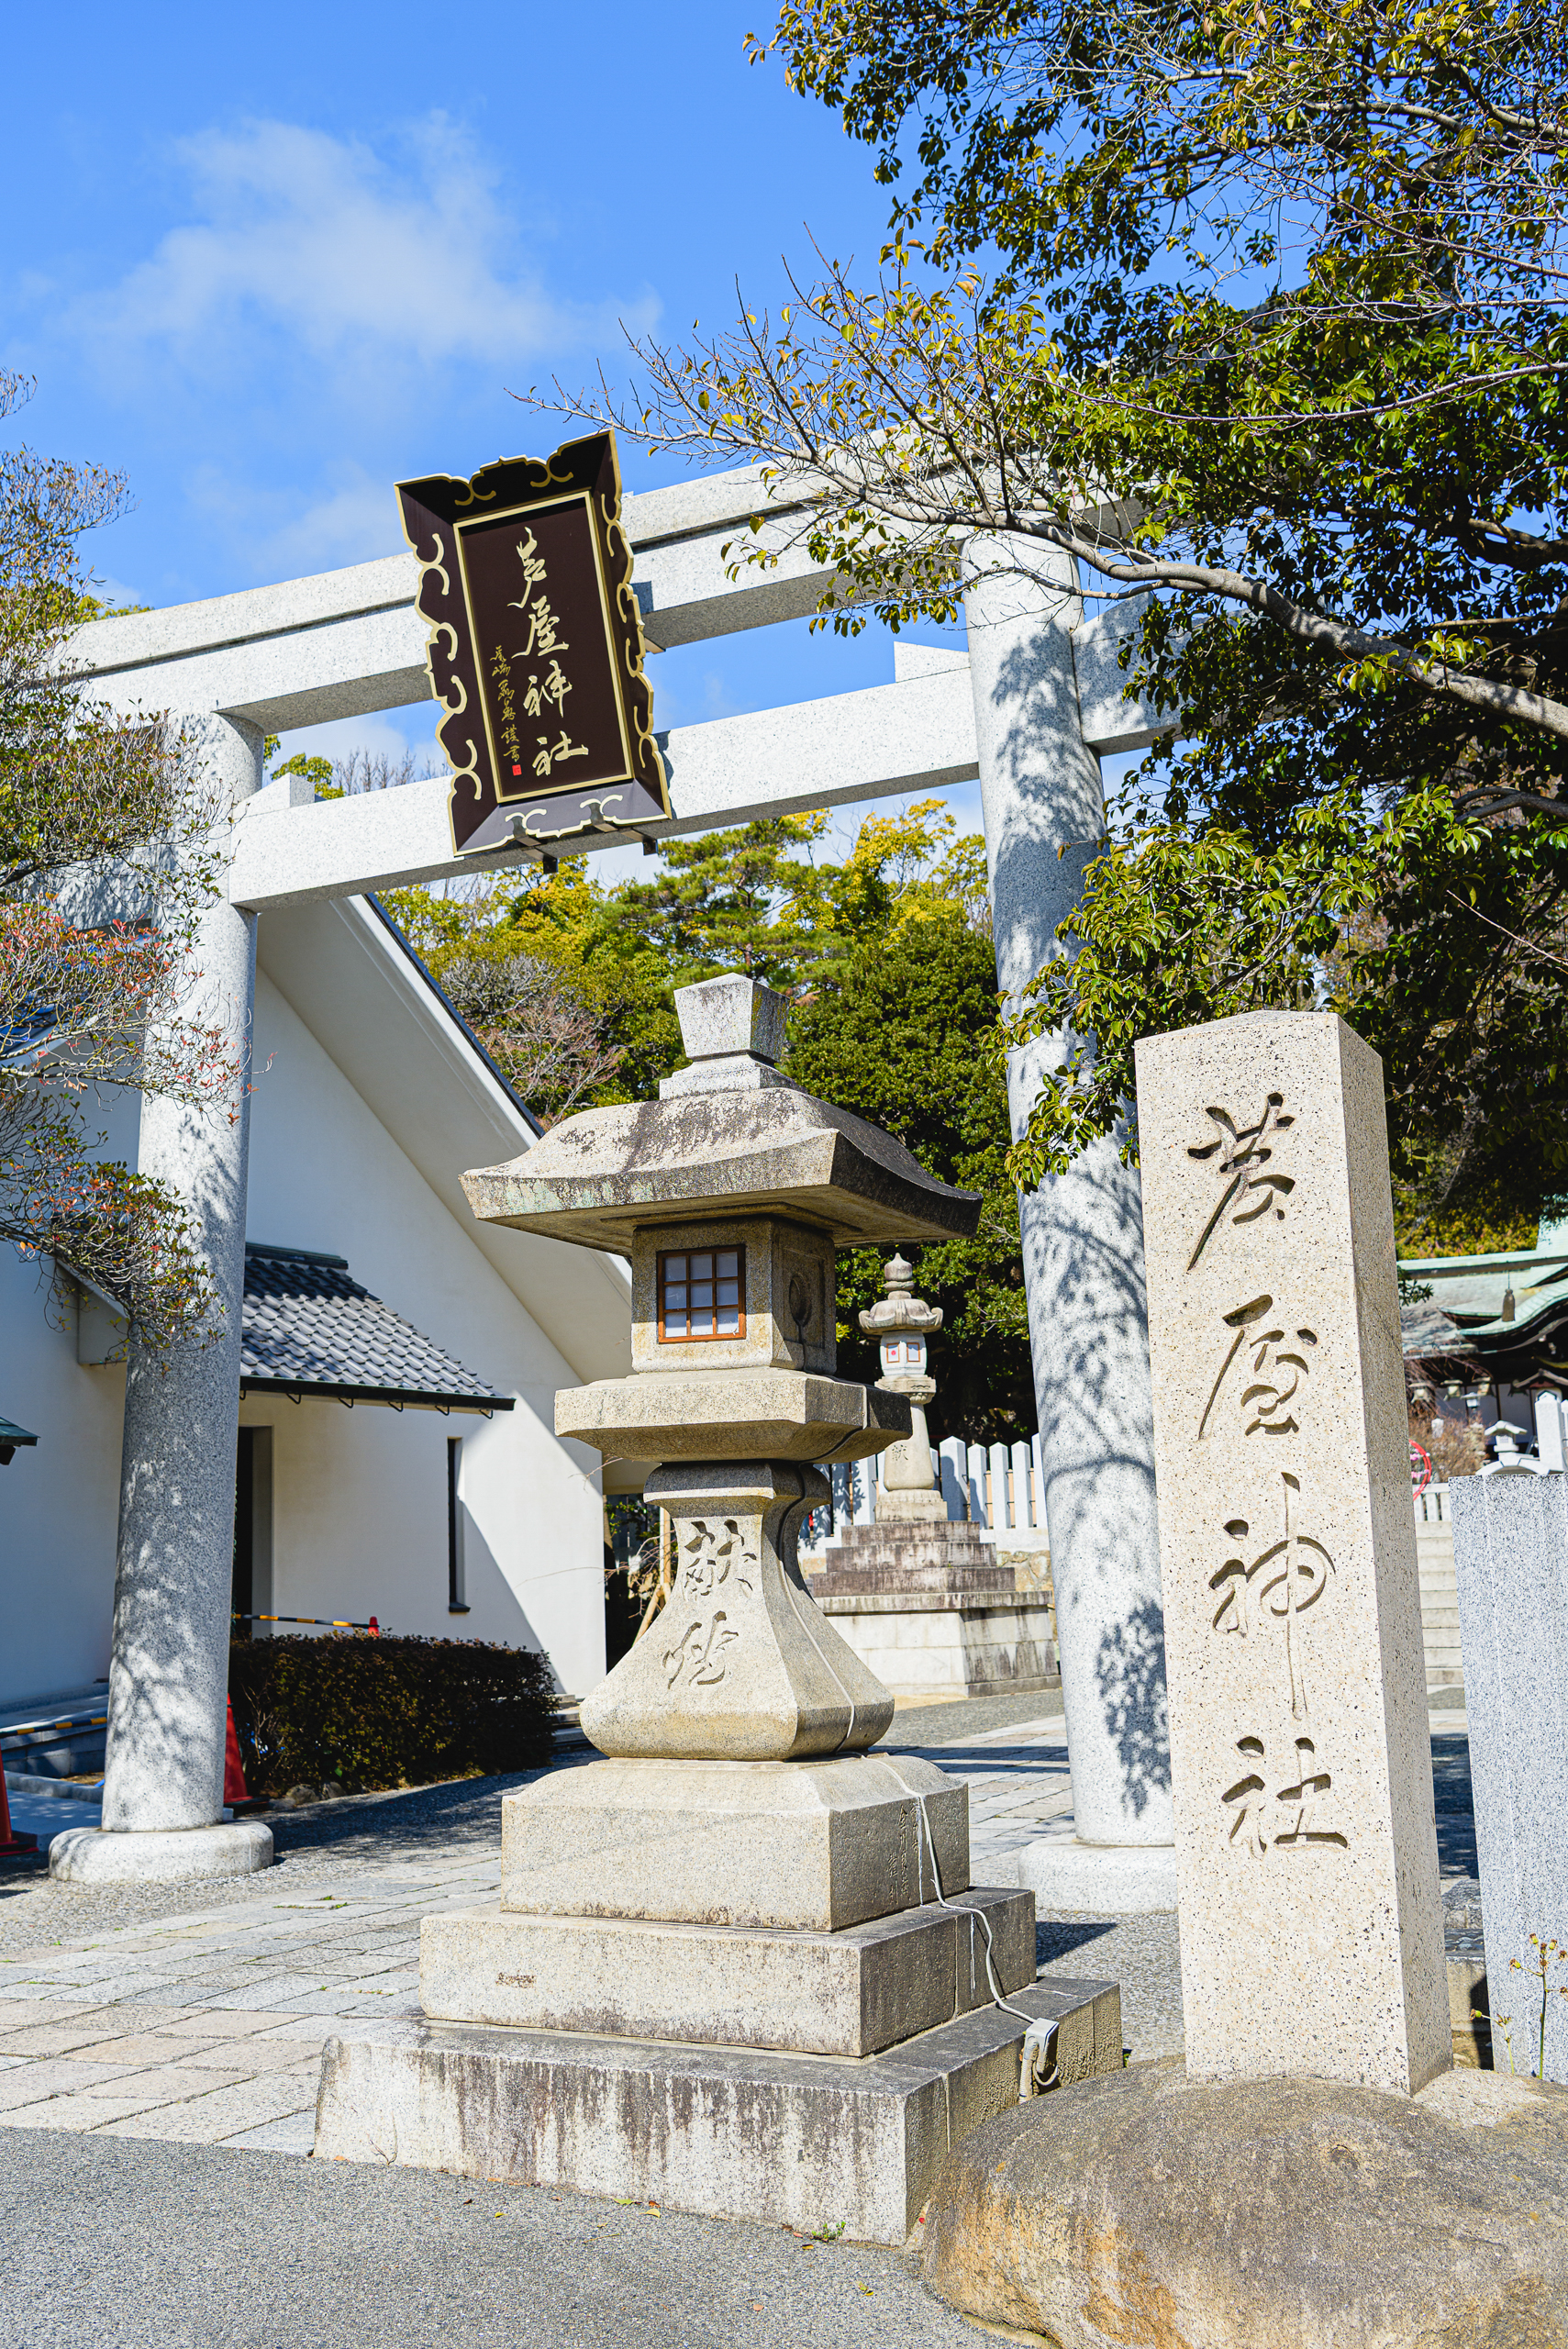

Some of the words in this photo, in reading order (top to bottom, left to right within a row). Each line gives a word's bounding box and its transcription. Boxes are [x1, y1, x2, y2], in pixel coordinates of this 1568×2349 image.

[506, 526, 589, 775] 芦屋神社
[1186, 1092, 1350, 1861] 芦屋神社
